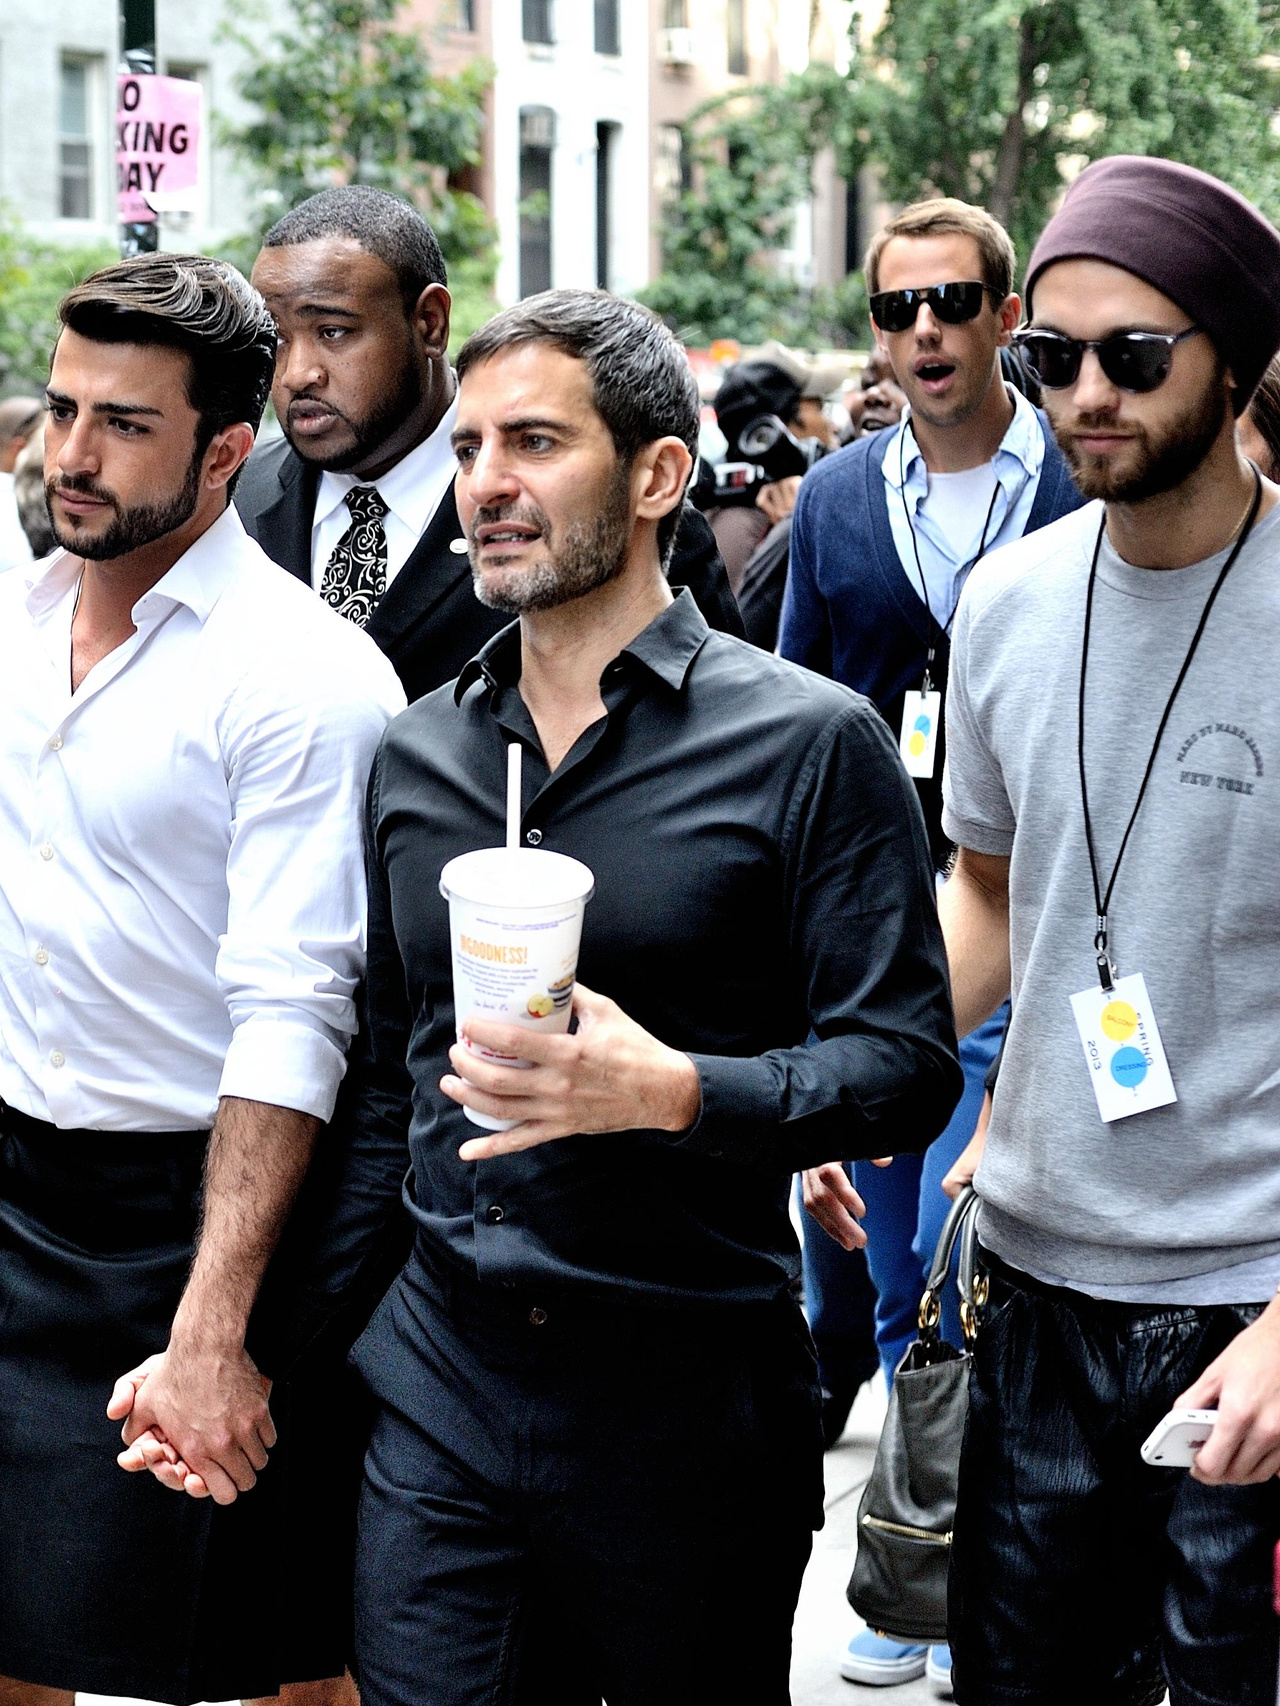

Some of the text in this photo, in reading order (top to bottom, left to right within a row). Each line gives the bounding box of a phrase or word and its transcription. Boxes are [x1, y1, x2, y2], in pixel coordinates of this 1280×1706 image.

[1180, 771, 1255, 795] NEW YORK
[1136, 1012, 1155, 1067] SPRING
[1087, 1040, 1102, 1071] 2013
